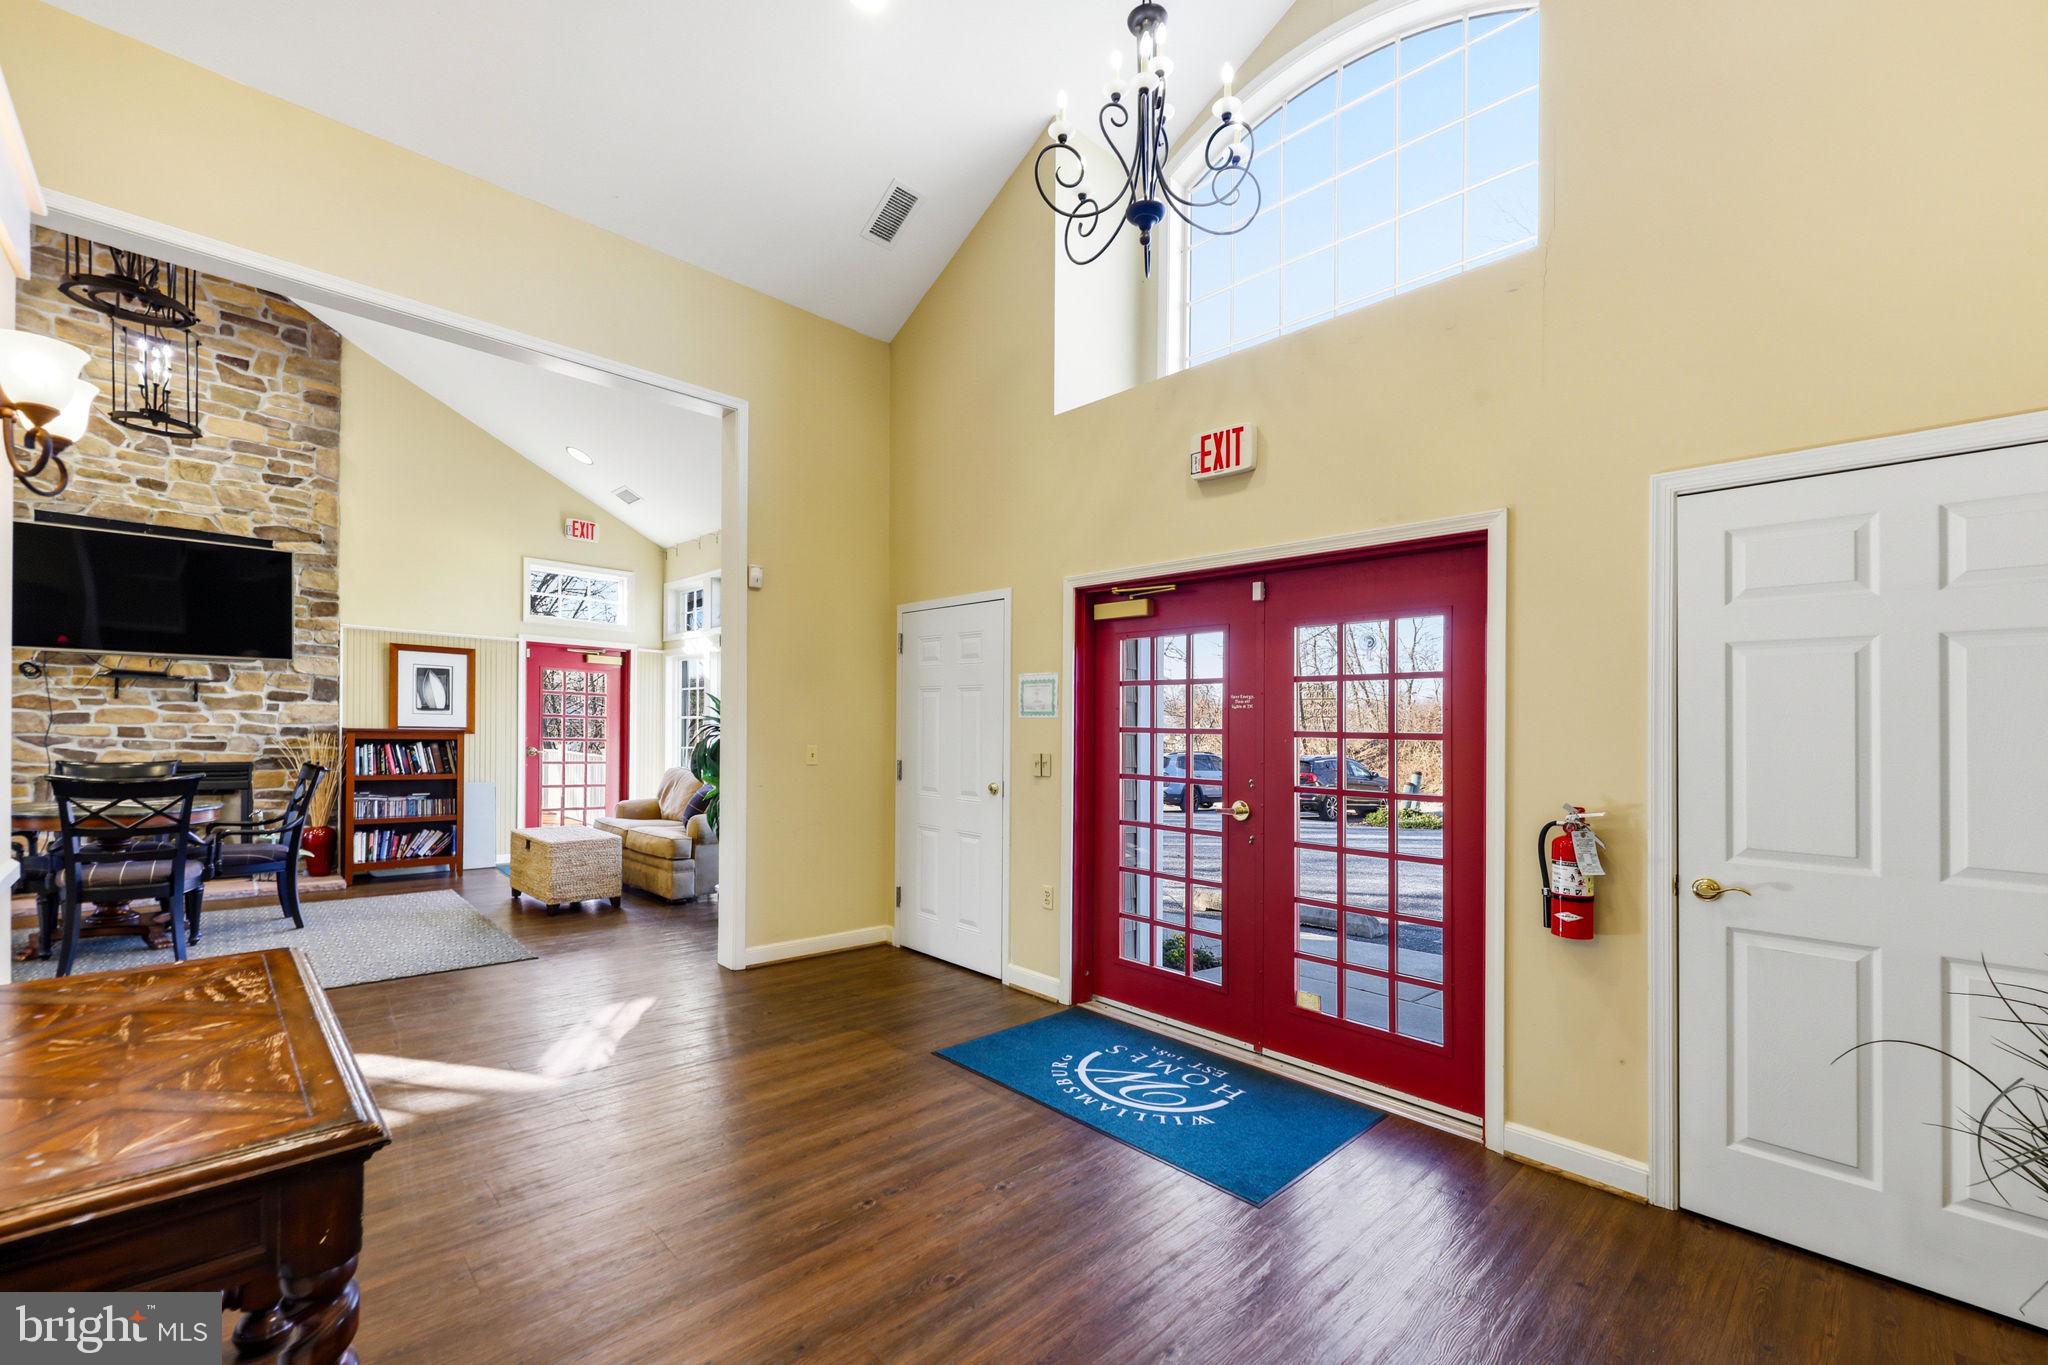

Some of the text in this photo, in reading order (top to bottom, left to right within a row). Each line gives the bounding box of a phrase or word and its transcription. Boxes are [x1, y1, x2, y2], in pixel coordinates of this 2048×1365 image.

[1200, 426, 1244, 474] EXIT
[572, 520, 595, 540] EXIT
[1051, 1054, 1216, 1125] WILLIAMSBURG
[1105, 1045, 1247, 1101] HOMES
